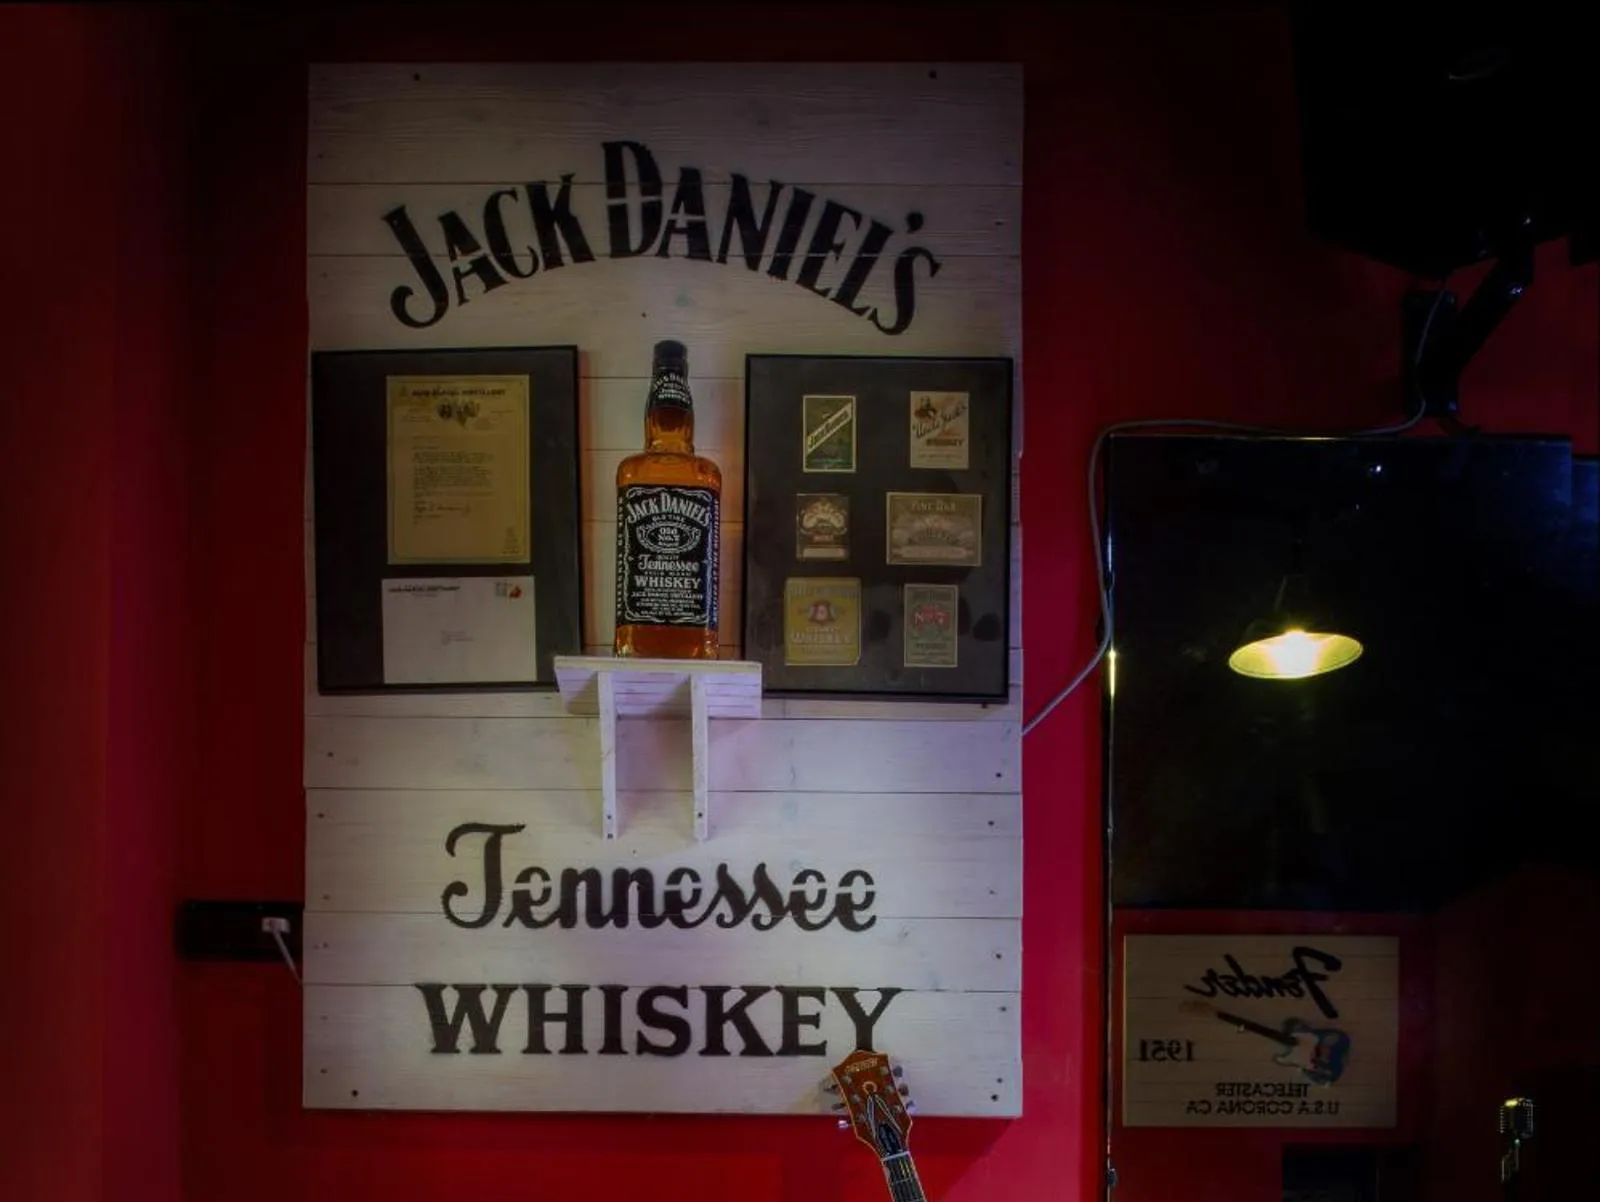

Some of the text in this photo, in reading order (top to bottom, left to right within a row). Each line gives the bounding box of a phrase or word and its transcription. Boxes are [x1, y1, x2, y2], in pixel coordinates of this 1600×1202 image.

[381, 140, 941, 335] JACK DANIEL'S
[627, 498, 660, 523] JACK
[634, 575, 702, 589] WHISKEY
[637, 554, 700, 573] Tennessee
[442, 822, 877, 932] Tennessee
[414, 983, 903, 1057] WHISKEY
